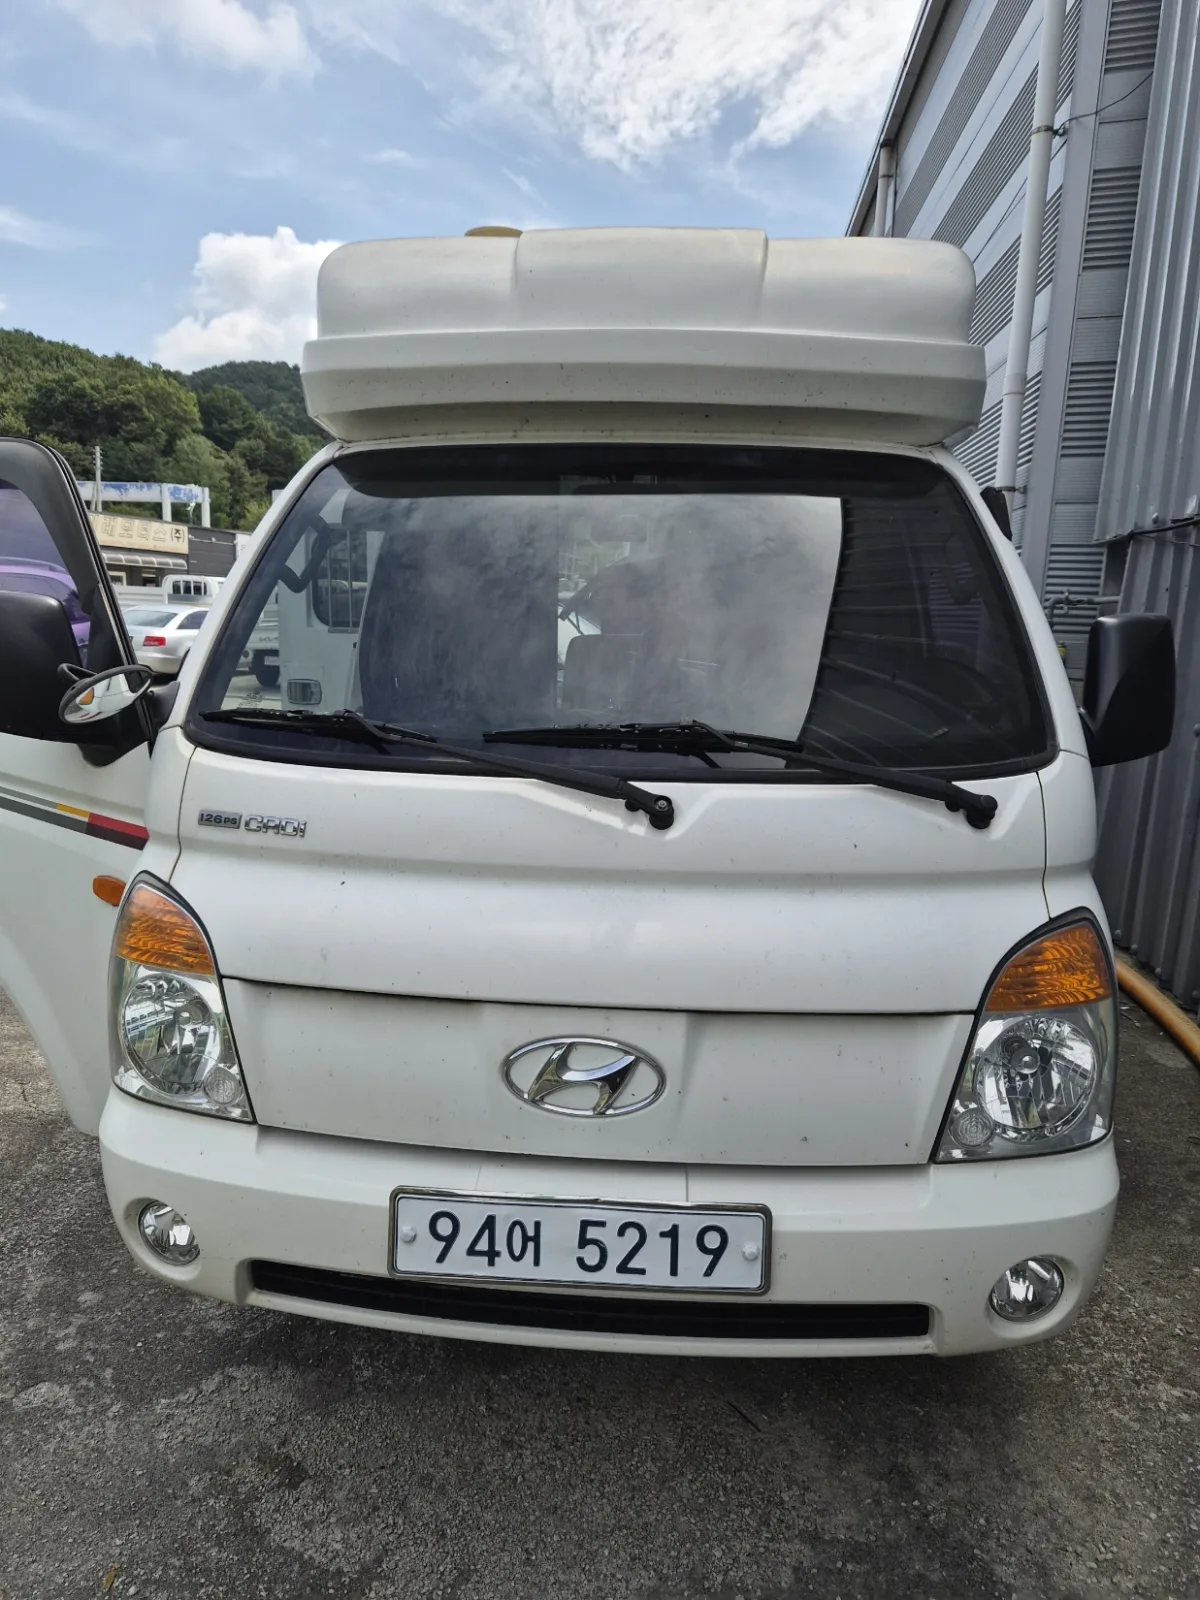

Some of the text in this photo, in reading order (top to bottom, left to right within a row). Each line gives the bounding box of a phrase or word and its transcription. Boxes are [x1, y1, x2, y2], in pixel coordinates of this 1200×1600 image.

[200, 813, 238, 825] 126PS
[428, 1210, 729, 1278] 94어 5219
